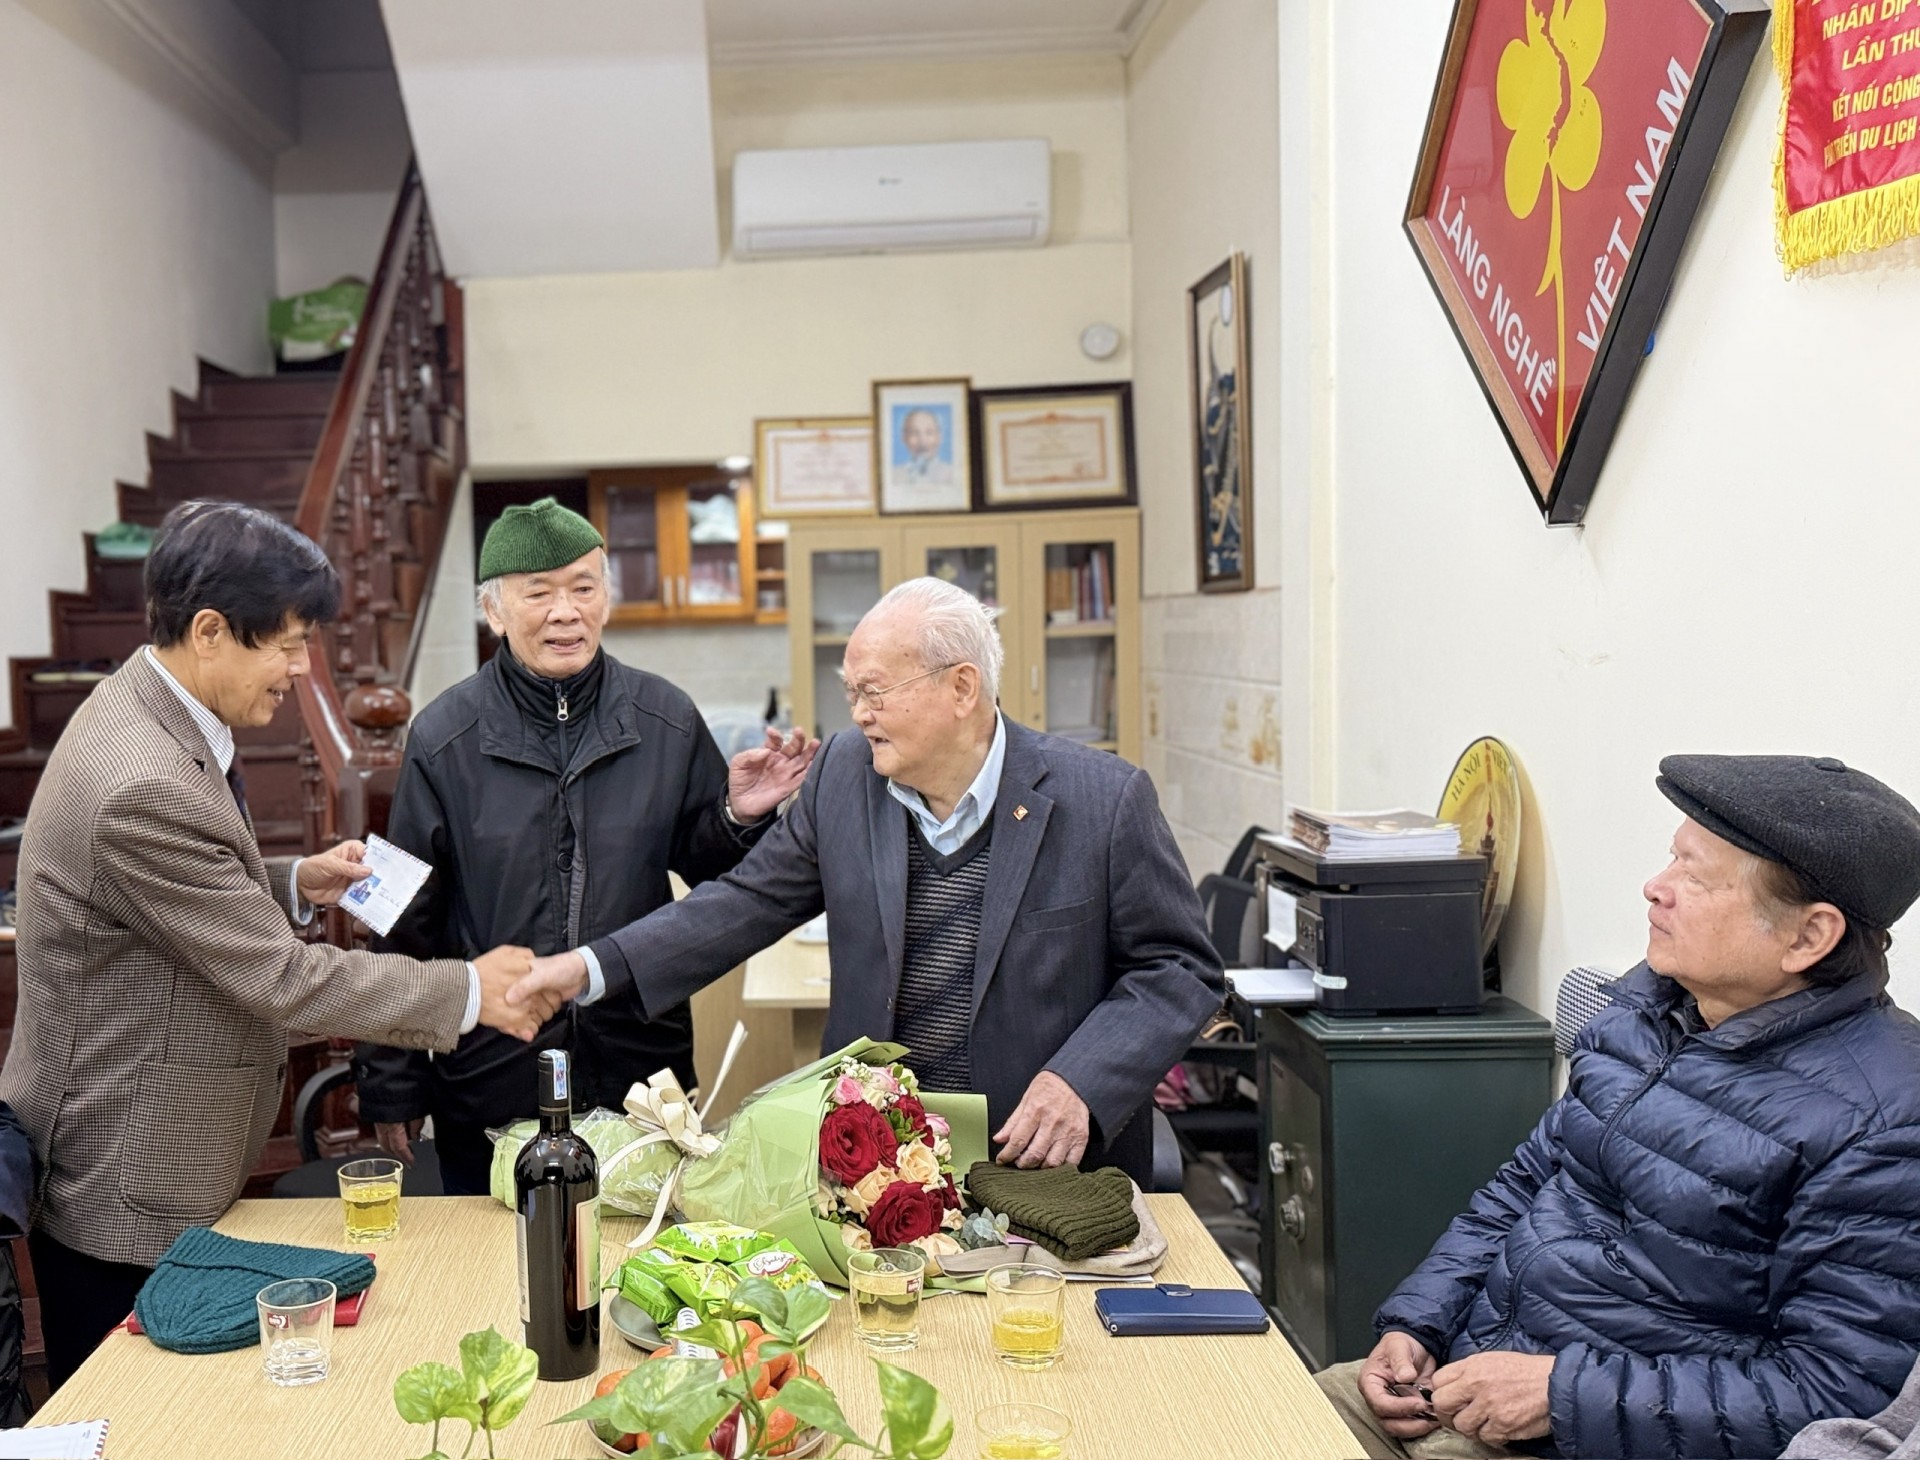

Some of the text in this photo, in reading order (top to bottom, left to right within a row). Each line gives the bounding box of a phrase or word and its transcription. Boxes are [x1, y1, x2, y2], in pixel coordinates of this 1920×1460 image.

[1822, 3, 1876, 41] NHÂN
[1841, 35, 1886, 71] LẦN
[1832, 73, 1920, 123] KẾT NỐI CỘNG
[1625, 56, 1692, 219] NAM
[1858, 121, 1881, 151] DU
[1882, 115, 1918, 150] LỊCH
[1438, 185, 1557, 418] LÀNG NGHỀ
